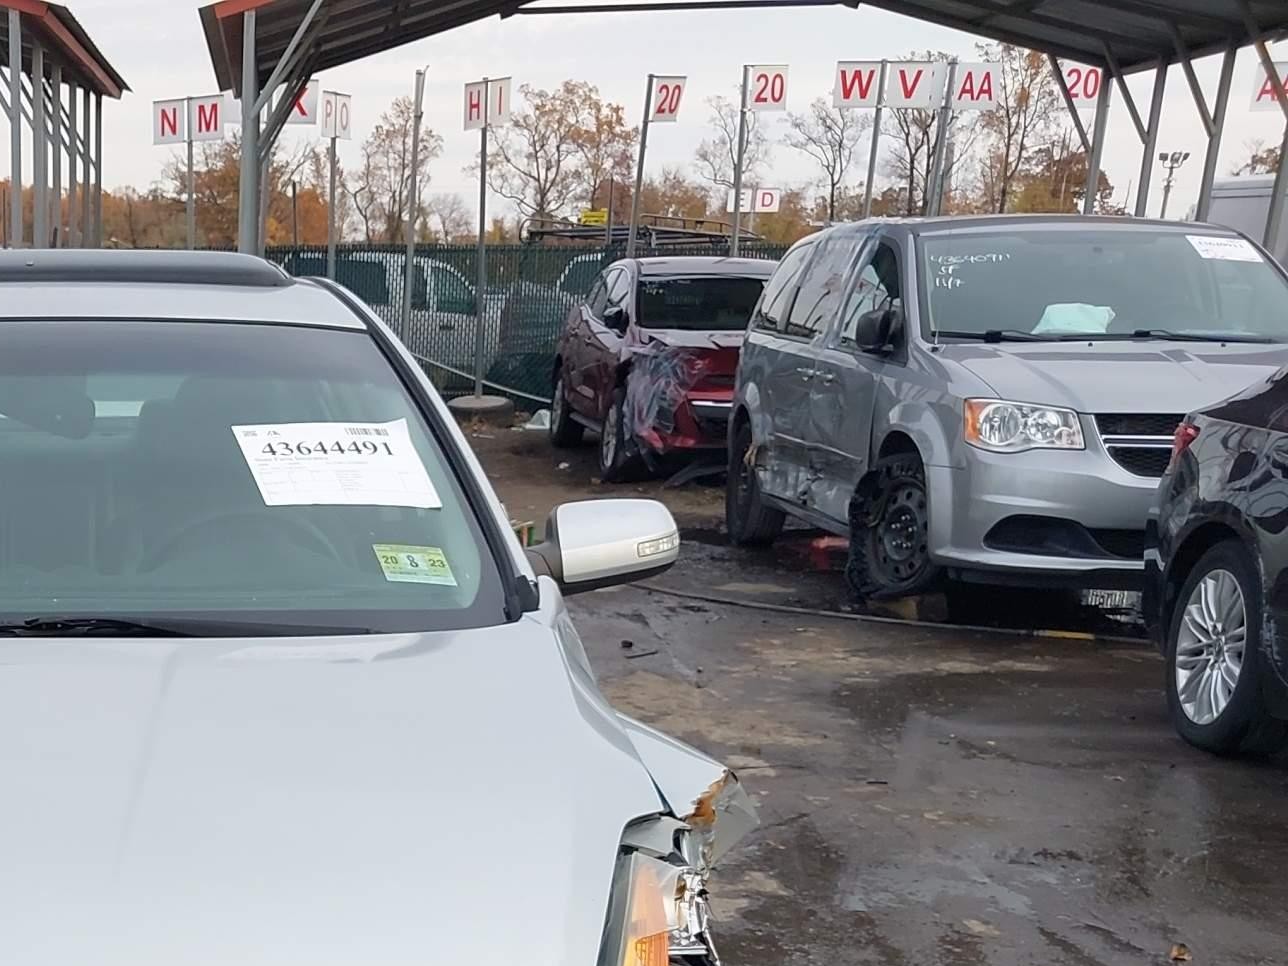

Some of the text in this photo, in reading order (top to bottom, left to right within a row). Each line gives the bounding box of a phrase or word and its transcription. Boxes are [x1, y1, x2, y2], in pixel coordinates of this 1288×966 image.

[753, 73, 785, 103] 20
[839, 69, 875, 100] W
[899, 69, 923, 99] V
[958, 71, 993, 101] AA
[1067, 68, 1102, 99] 20
[324, 99, 333, 129] P
[468, 89, 481, 121] H
[655, 84, 681, 115] 20
[160, 107, 178, 137] N
[198, 102, 218, 133] M
[340, 101, 349, 131] O
[761, 192, 774, 207] D
[261, 440, 395, 456] 43644491
[382, 554, 446, 568] 20 8 23
